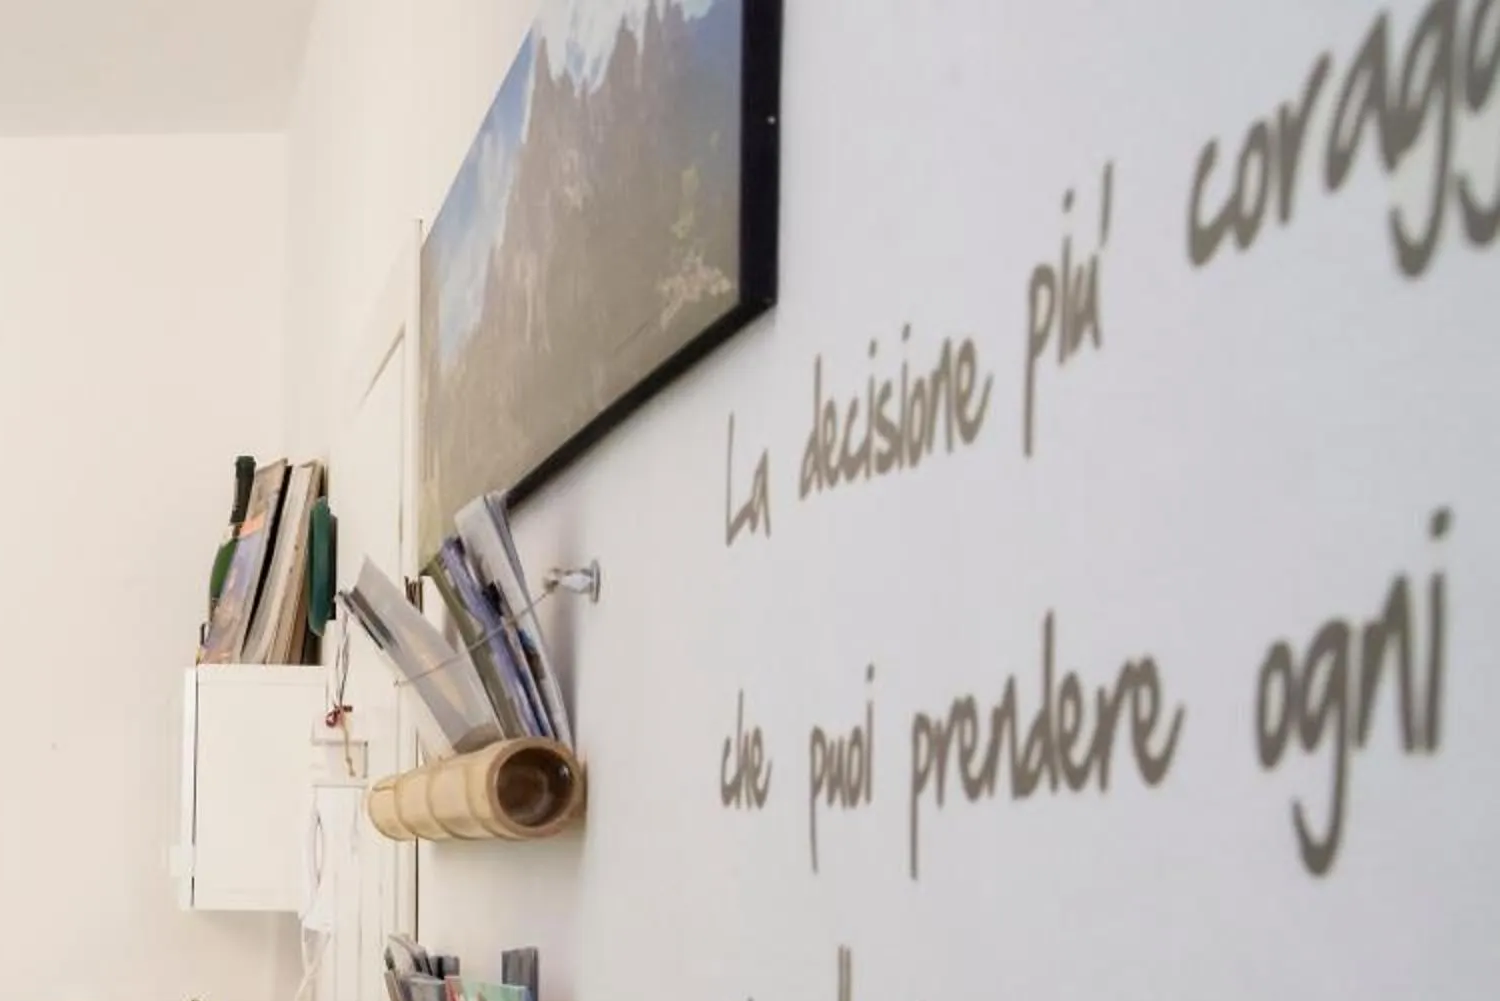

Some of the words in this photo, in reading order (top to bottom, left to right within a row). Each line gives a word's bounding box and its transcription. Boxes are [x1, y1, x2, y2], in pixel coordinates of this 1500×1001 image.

[725, 412, 771, 547] La
[799, 324, 993, 502] decisione
[720, 688, 772, 810] che
[810, 662, 875, 875] puoi
[911, 609, 1185, 880] prendere
[1256, 505, 1453, 878] ogni
